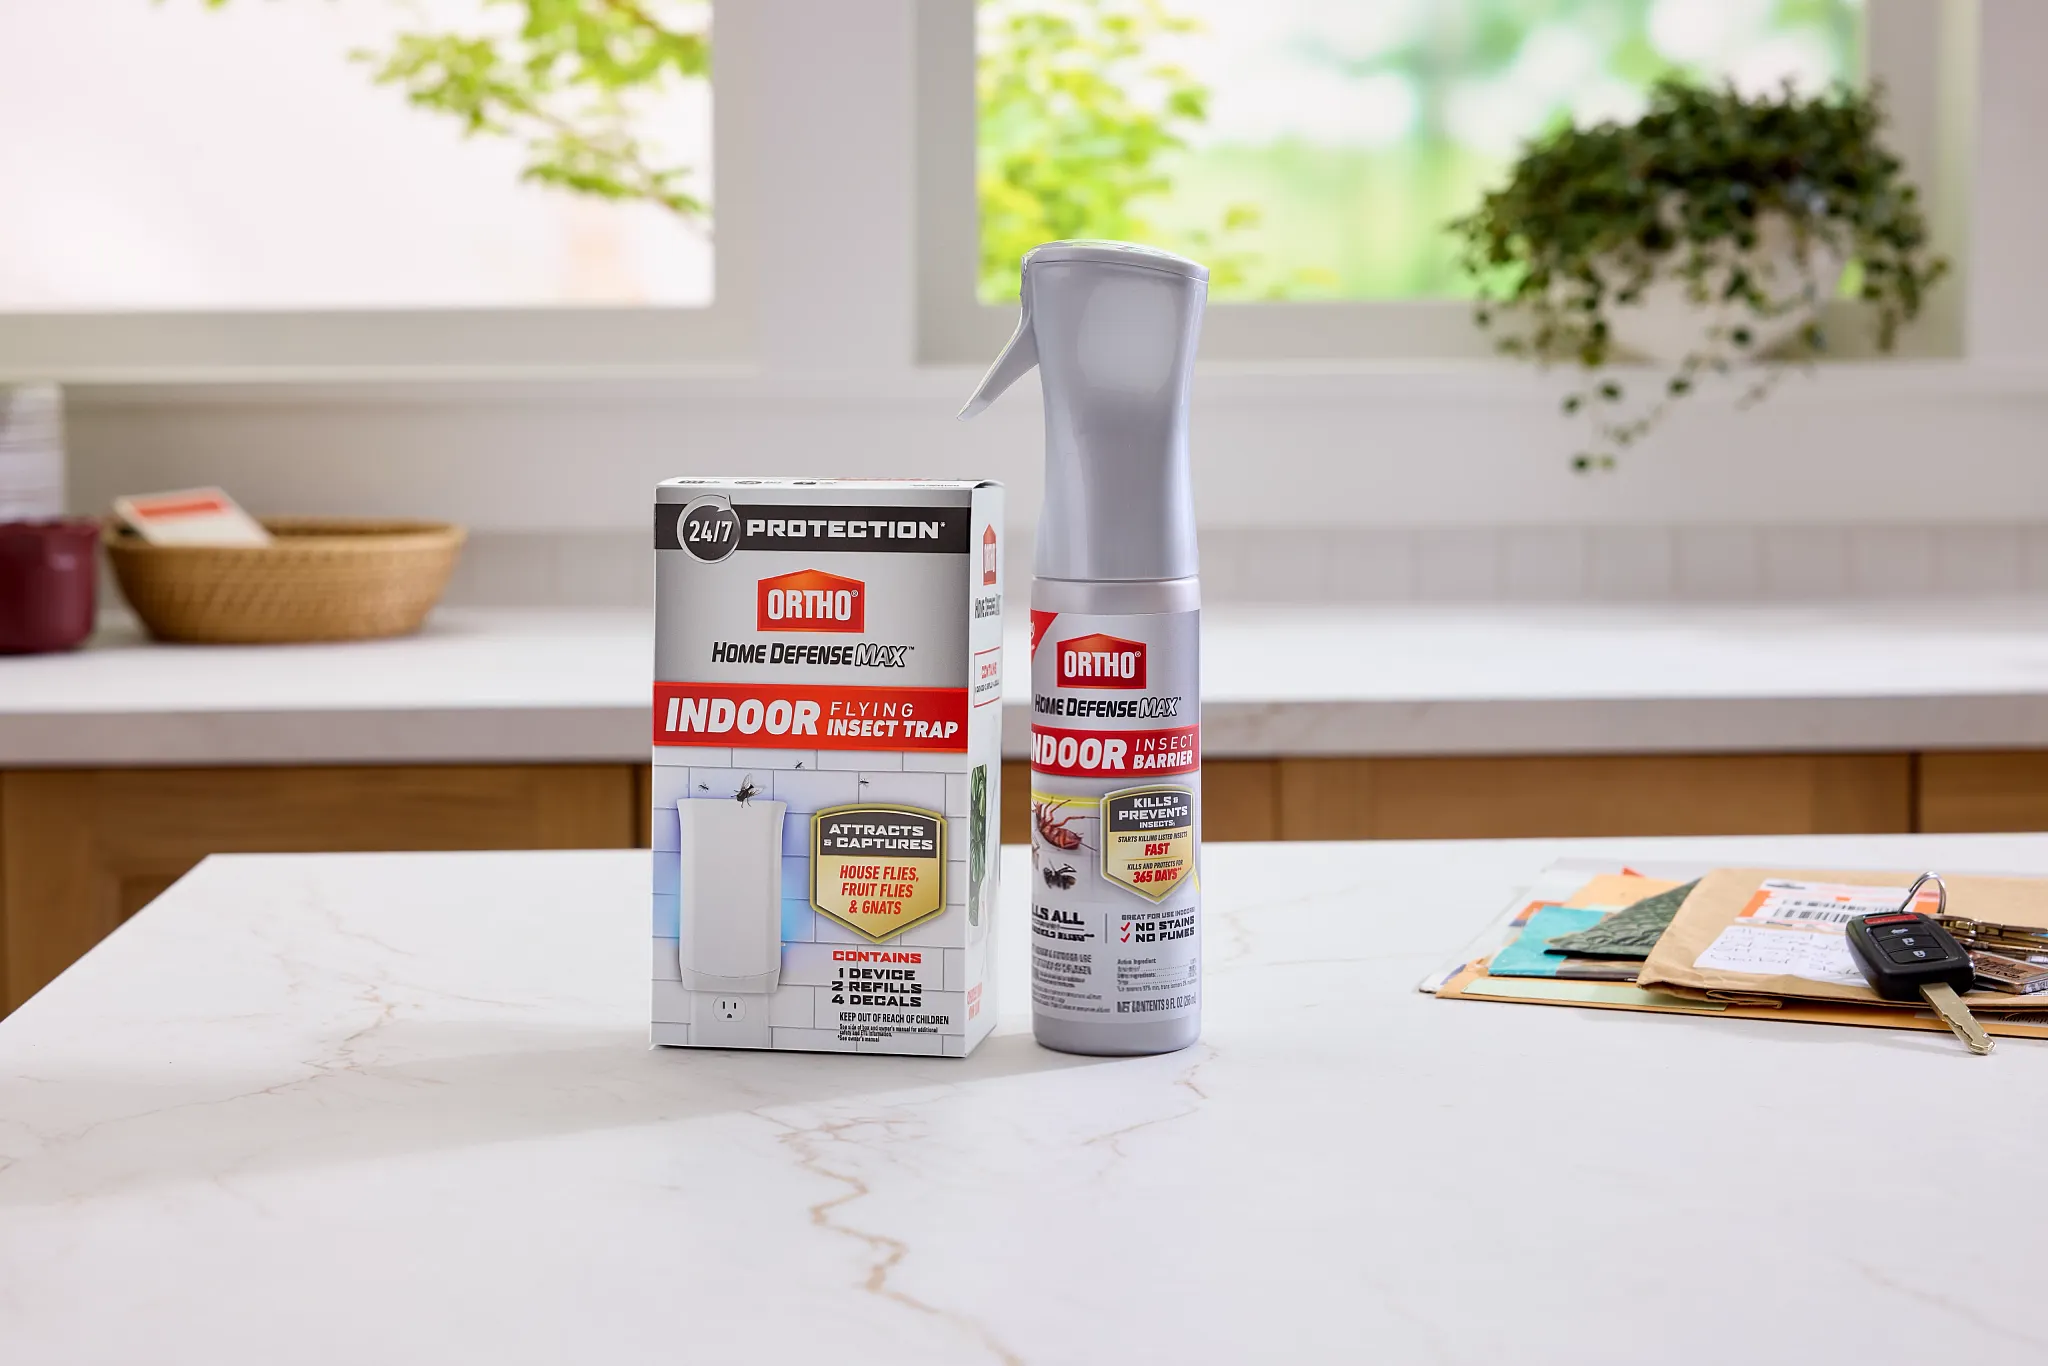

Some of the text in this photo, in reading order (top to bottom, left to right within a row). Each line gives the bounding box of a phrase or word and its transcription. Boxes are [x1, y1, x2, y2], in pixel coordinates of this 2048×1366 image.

[689, 520, 733, 543] 24/7
[712, 641, 767, 664] HOME
[770, 642, 853, 666] DEFENSE
[830, 701, 914, 718] FLYING
[1034, 693, 1063, 716] HOME
[1066, 697, 1138, 718] DEFENSE
[665, 697, 821, 736] INDOOR
[827, 718, 959, 739] INSECT TRAP
[1135, 733, 1194, 752] INSECT
[1031, 732, 1128, 770] NDOOR
[1133, 750, 1193, 770] BARRIER
[1133, 796, 1172, 809] KILLS
[1118, 805, 1188, 821] PREVENTS
[829, 823, 924, 837] ATTRACTS
[836, 837, 933, 850] CAPTURES
[1144, 842, 1171, 857] FAST
[839, 865, 919, 882] HOUSE FLIES,
[1132, 869, 1152, 884] 365
[841, 882, 914, 898] FRUIT FLIES
[848, 899, 902, 915] & GNATS
[1051, 911, 1085, 926] ALL
[1135, 915, 1195, 932] NO STAINS
[1147, 912, 1161, 920] FOR
[1135, 926, 1195, 943] NO FUMES
[832, 950, 922, 964] CONTAINS
[838, 967, 916, 981] 1 DEVICE
[832, 981, 922, 994] 2 REFILLS
[831, 994, 922, 1007] 4 DECALS
[1132, 999, 1165, 1013] CONTENTS
[839, 1012, 949, 1025] KEEP OUT OF REACH OF CHILDREN
